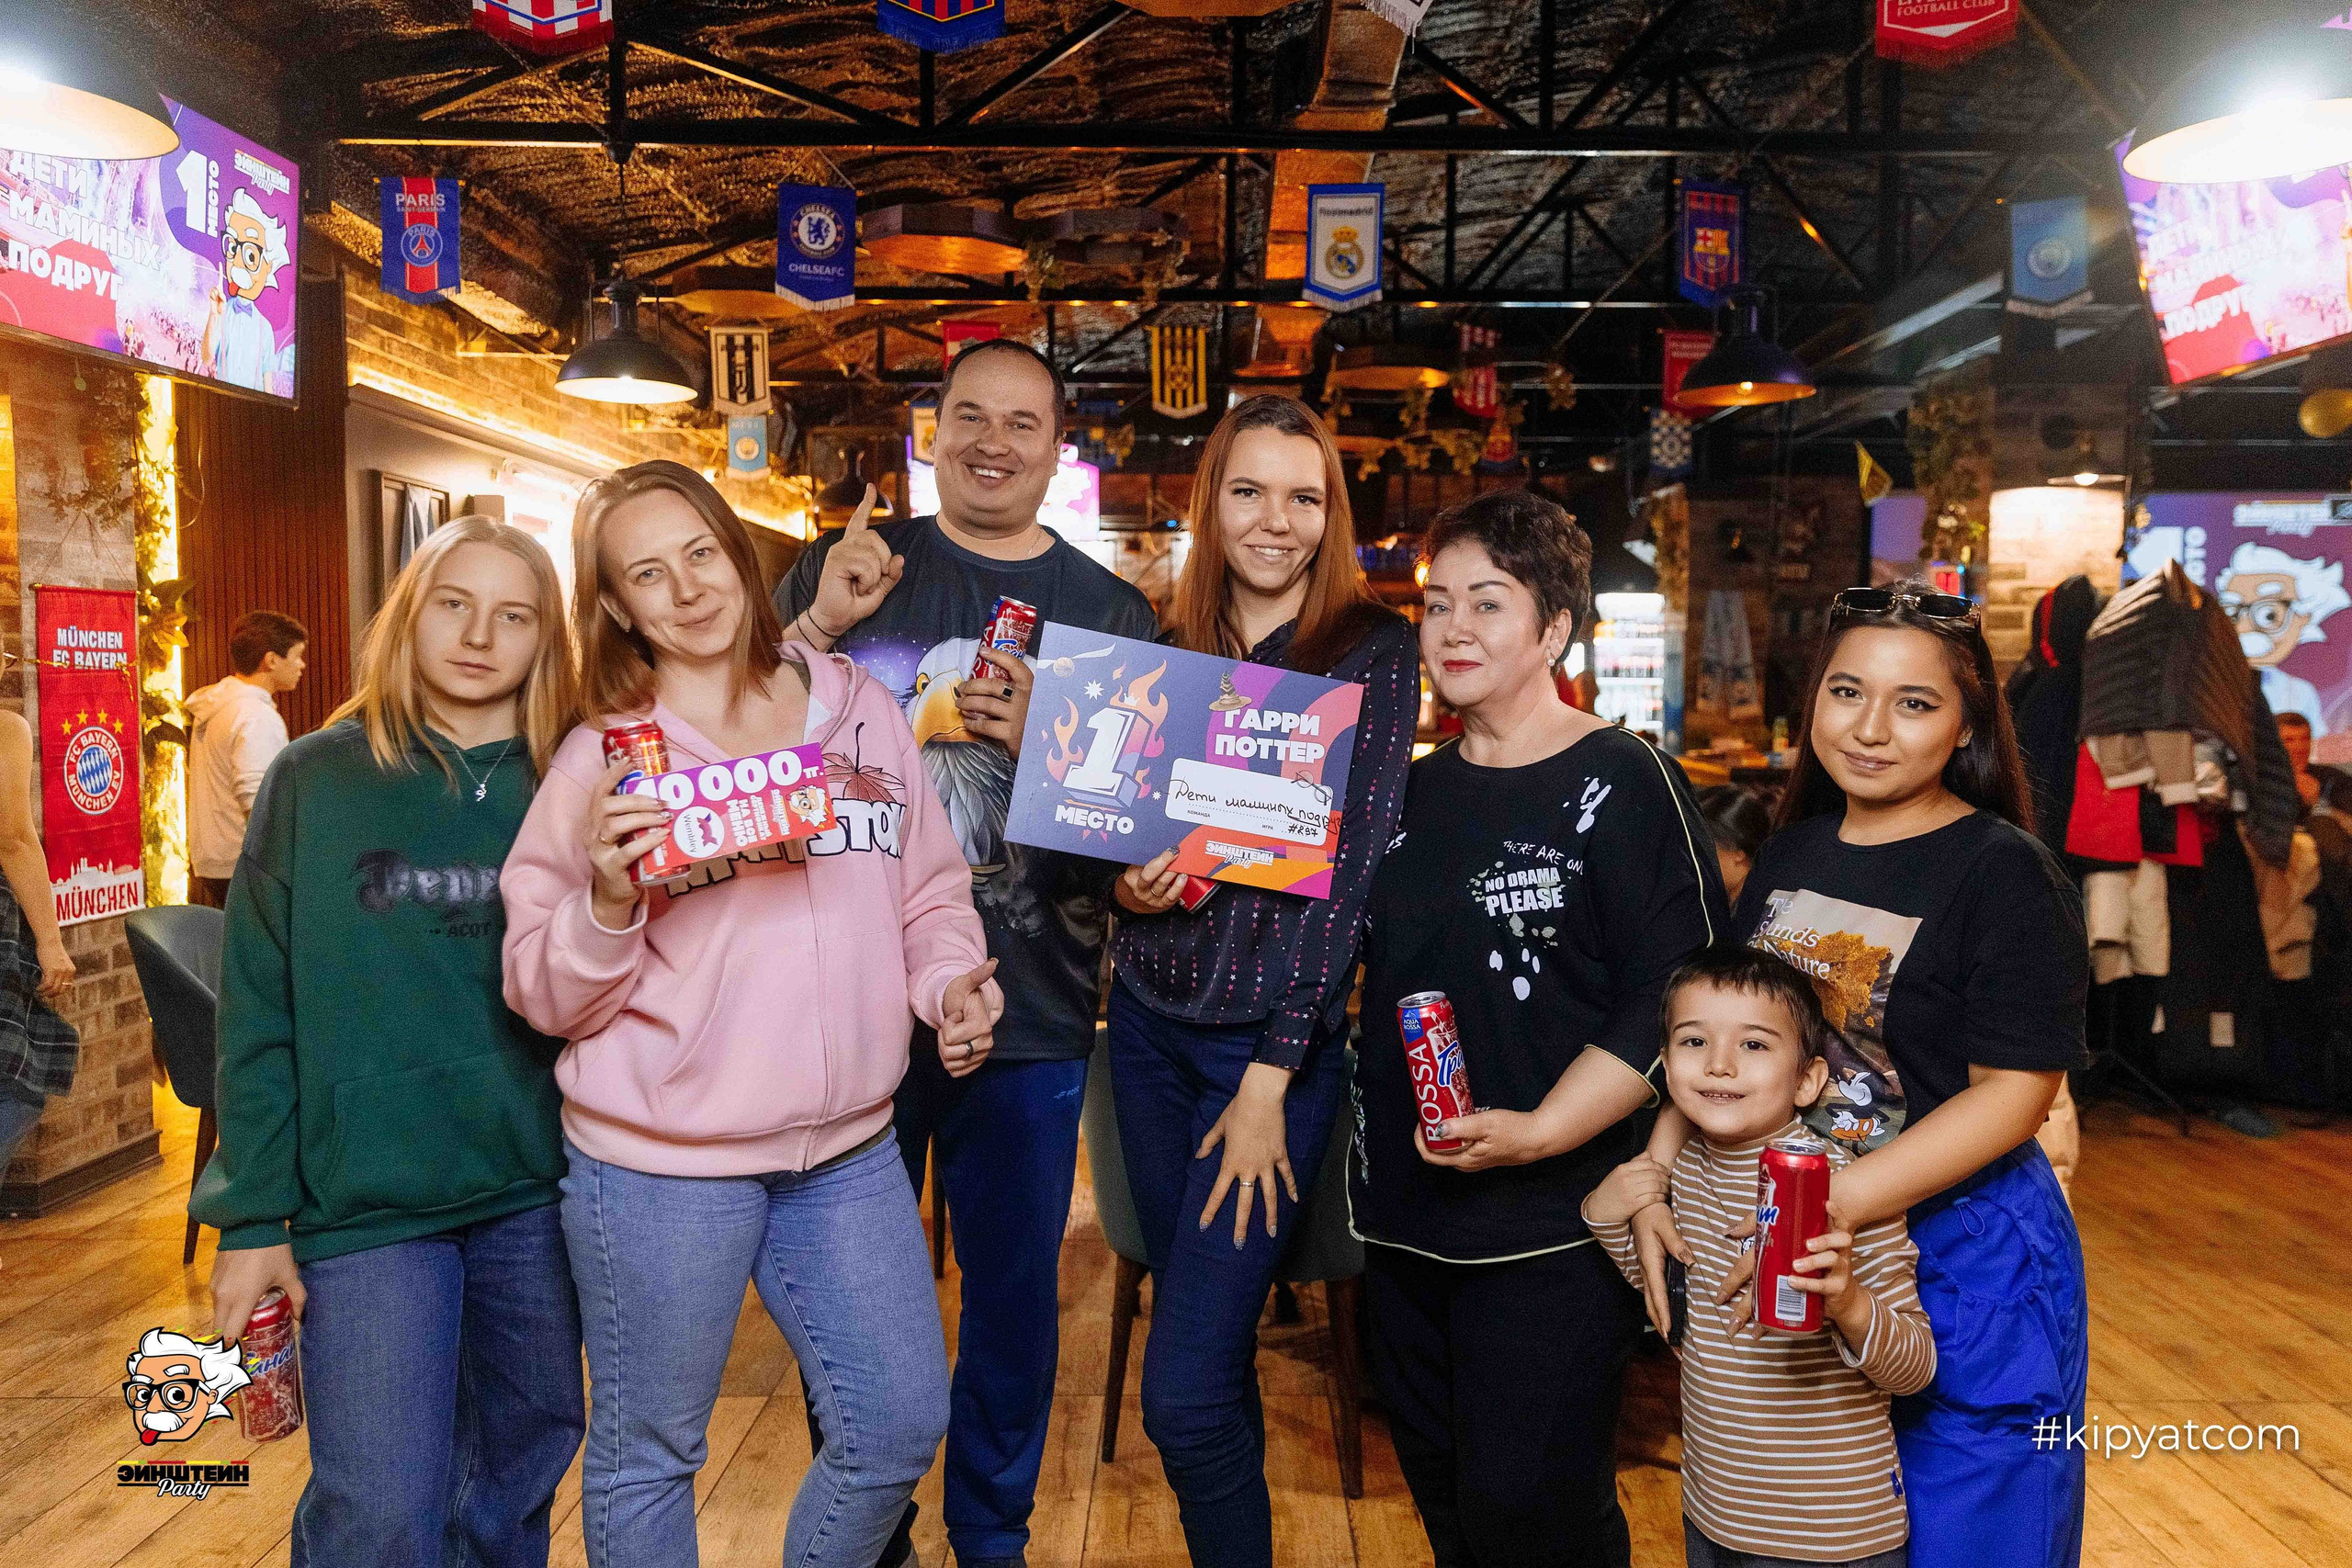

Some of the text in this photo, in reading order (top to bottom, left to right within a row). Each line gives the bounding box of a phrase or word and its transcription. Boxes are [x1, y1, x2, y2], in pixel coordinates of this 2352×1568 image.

[1897, 0, 1960, 17] FOOTBALL
[10, 151, 87, 199] ДЕТИ
[175, 150, 220, 239] 1 МЕСТО
[395, 193, 446, 207] PARIS
[9, 191, 161, 272] МАМИНЫХ
[8, 239, 124, 301] ПОДРУГ
[57, 626, 123, 649] MÜNCHEN
[52, 649, 128, 671] FC BAYERN
[1224, 708, 1321, 737] ГАРРИ
[69, 731, 119, 763] FC BAYERN
[1062, 706, 1136, 797] 1
[1215, 733, 1325, 764] ПОТТЕР
[726, 798, 748, 847] МЕНЮ
[738, 798, 758, 843] НА ВСЕ
[808, 797, 906, 858] STO
[1055, 804, 1135, 835] МЕСТО
[1187, 809, 1211, 818] КОМАНДА
[683, 814, 697, 853] Wembley
[1223, 853, 1253, 869] Party
[1503, 840, 1536, 855] THERE
[1535, 845, 1565, 865] ARE
[1485, 867, 1561, 892] NO DRAMA
[55, 881, 139, 921] MÜNCHEN
[1485, 886, 1565, 917] PLEASE
